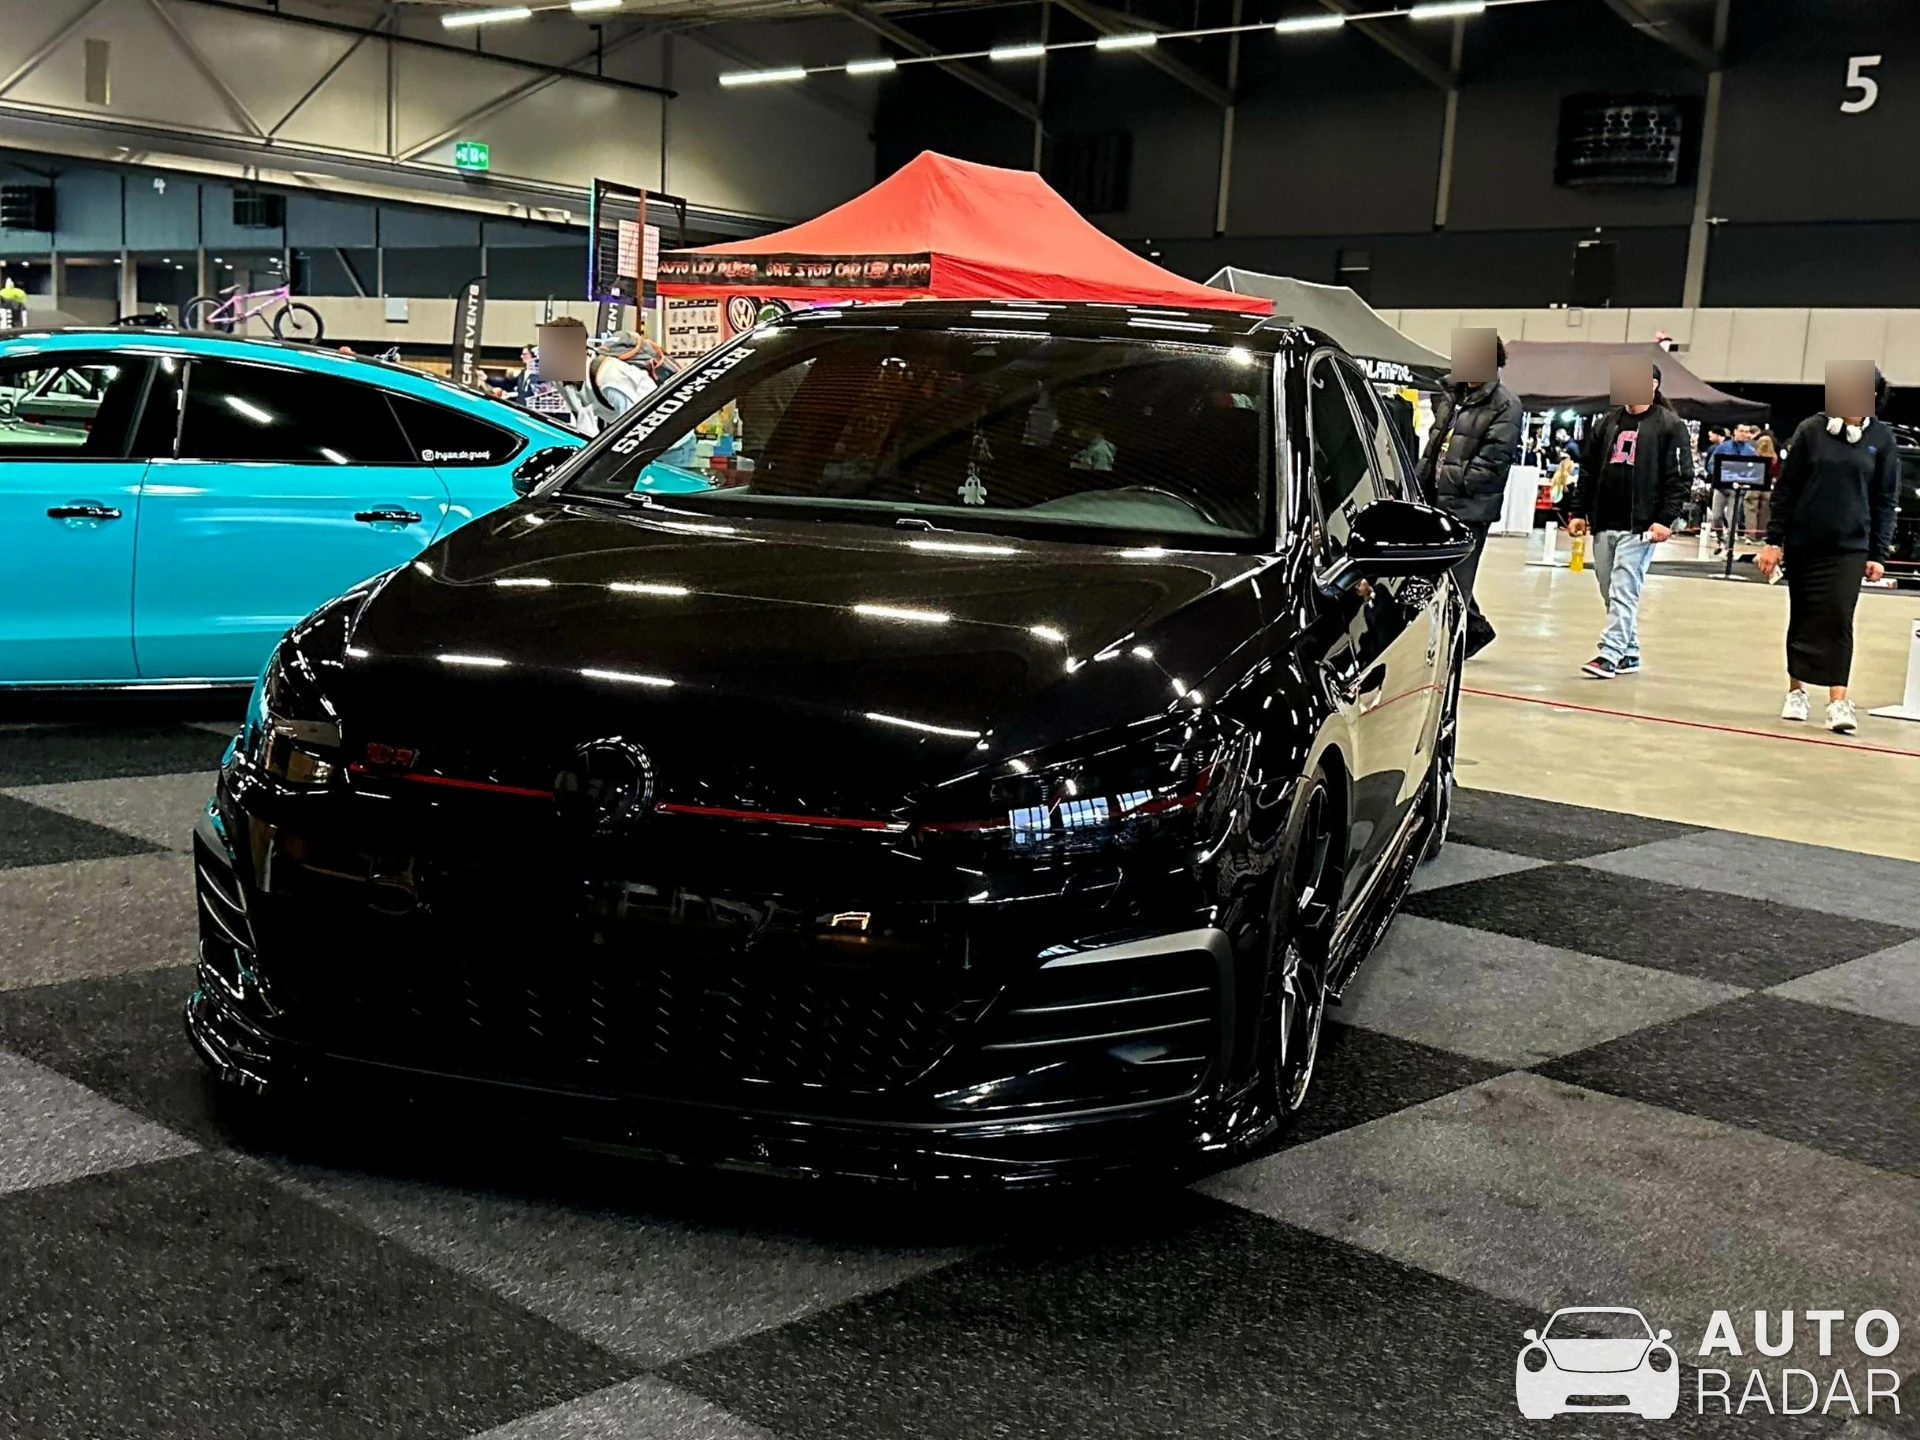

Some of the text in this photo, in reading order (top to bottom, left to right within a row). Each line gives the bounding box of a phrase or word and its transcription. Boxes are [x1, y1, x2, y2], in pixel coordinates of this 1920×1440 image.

[1840, 54, 1882, 113] 5
[153, 177, 166, 195] 4
[658, 262, 690, 275] AUTO
[765, 262, 793, 277] ONE
[795, 263, 833, 278] STOP
[731, 298, 756, 332] VW
[461, 284, 480, 385] CAR EVENTS
